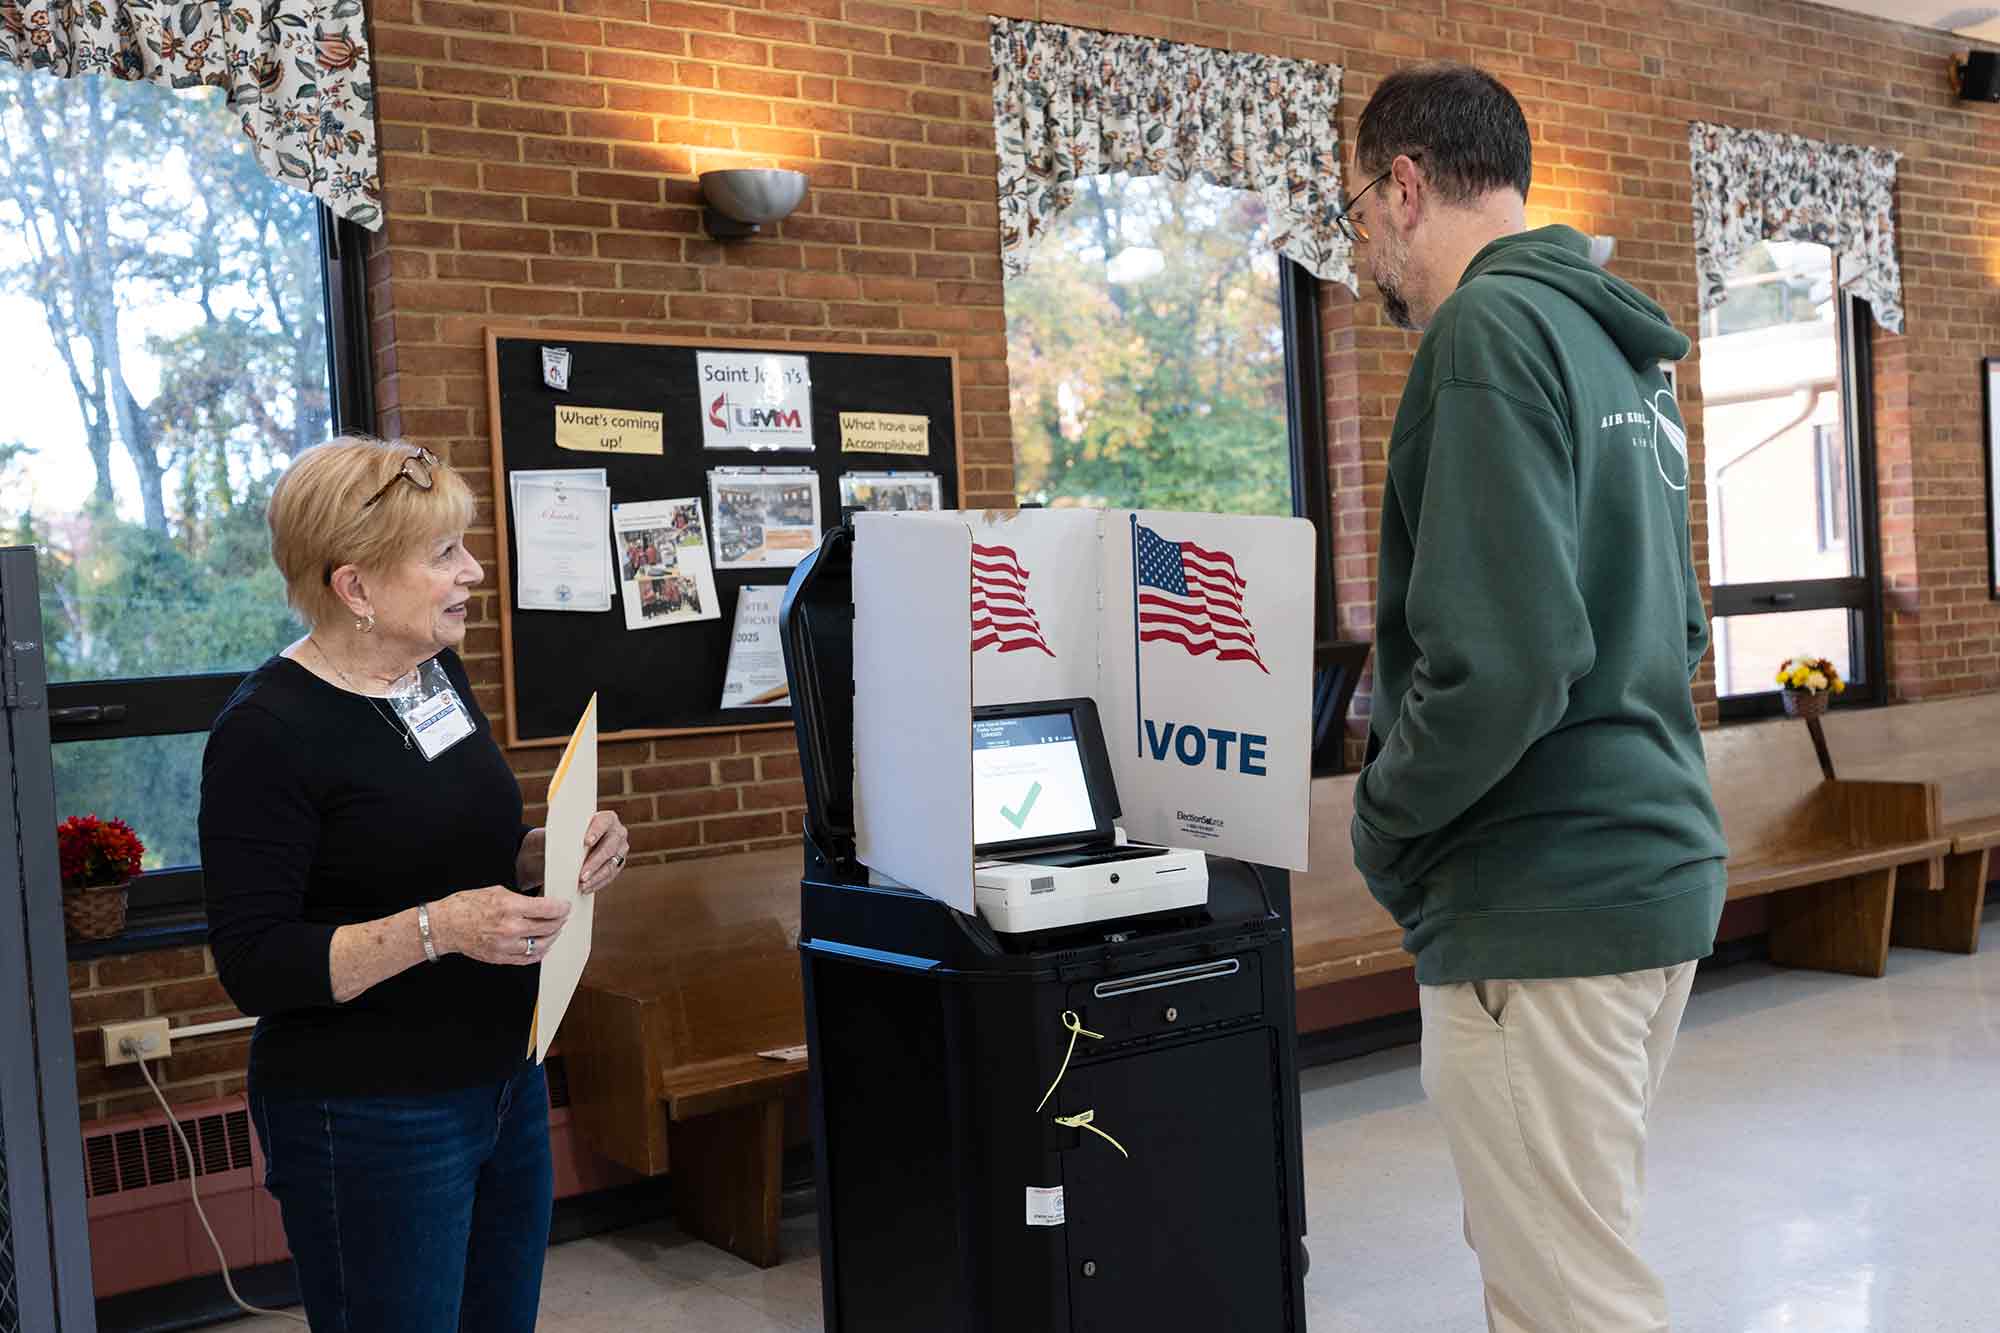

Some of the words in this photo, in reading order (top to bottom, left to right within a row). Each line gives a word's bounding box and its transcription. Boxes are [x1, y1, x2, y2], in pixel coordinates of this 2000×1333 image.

[704, 365, 749, 383] Saint
[560, 411, 608, 426] What's
[611, 416, 660, 432] coming
[842, 417, 875, 431] What
[878, 421, 906, 433] have
[908, 424, 925, 433] we
[1601, 413, 1623, 428] AIR
[600, 435, 623, 449] up!
[845, 437, 925, 451] Accomplished!
[735, 631, 760, 642] 2025
[1144, 719, 1267, 777] VOTE
